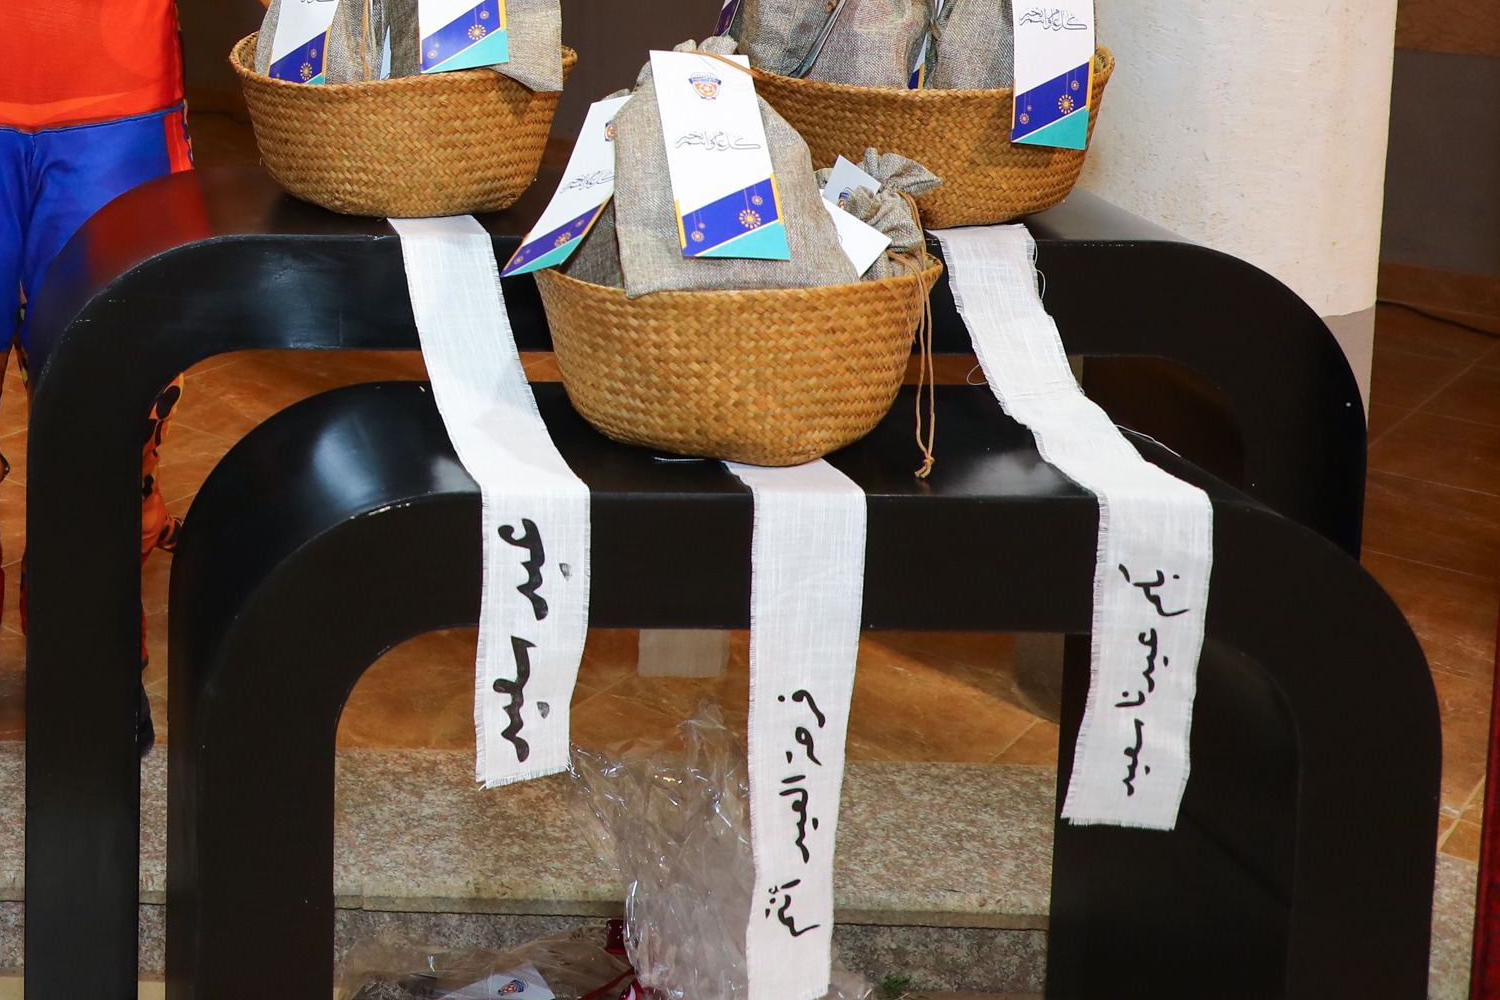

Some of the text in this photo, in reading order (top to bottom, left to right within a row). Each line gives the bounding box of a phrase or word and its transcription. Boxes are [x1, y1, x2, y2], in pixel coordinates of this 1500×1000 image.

[492, 518, 571, 763] عيد سعيد
[1114, 563, 1189, 797] بكم عيدنا سعيد
[765, 689, 826, 938] فرحة العيد أنتم
